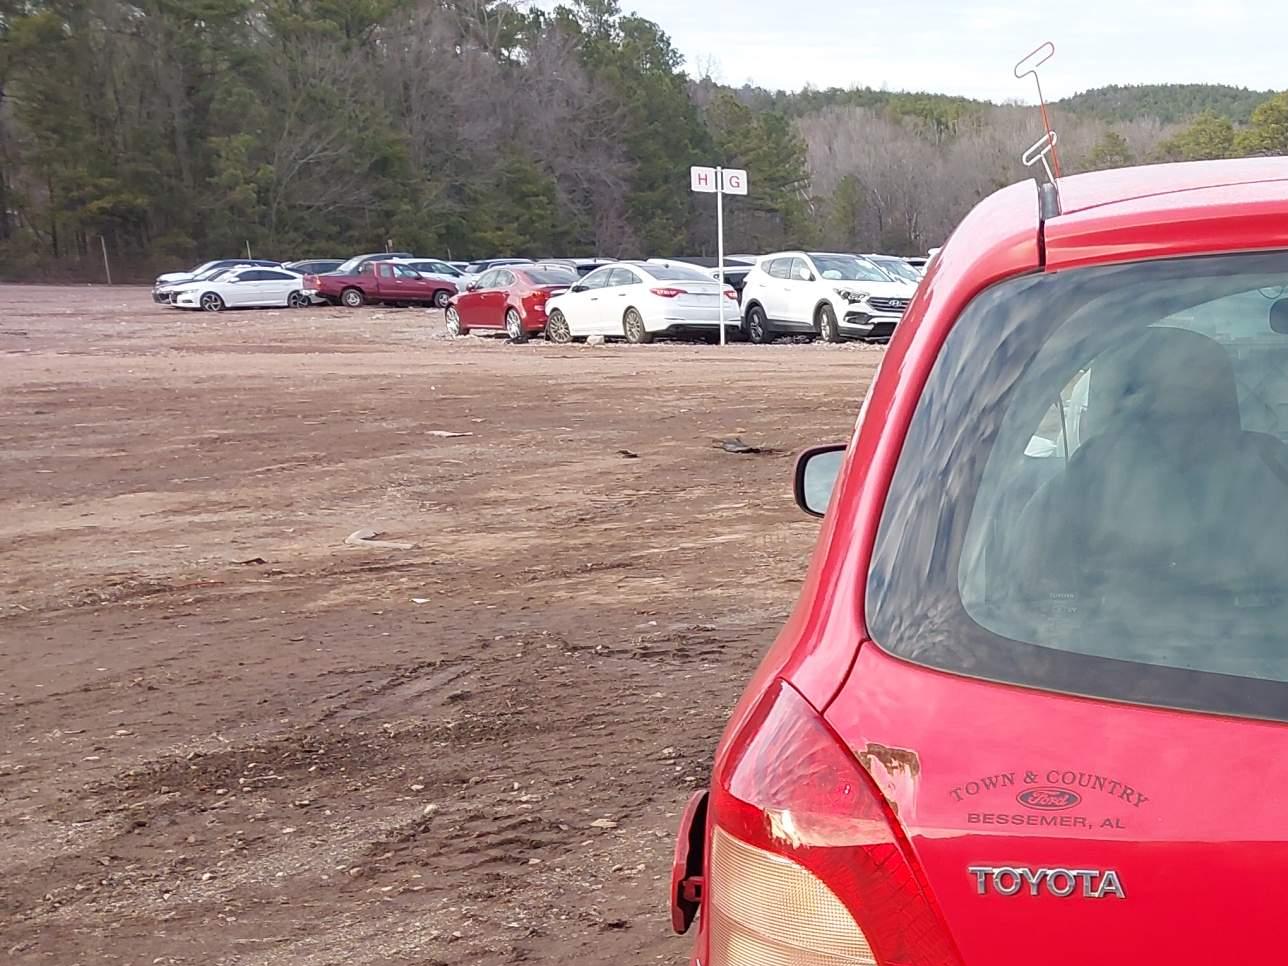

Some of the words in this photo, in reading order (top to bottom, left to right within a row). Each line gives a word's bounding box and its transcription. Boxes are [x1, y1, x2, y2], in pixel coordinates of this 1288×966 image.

[698, 173, 708, 186] H
[729, 176, 741, 188] G
[952, 773, 1015, 802] TOWN
[1023, 771, 1038, 784] &
[1047, 771, 1149, 807] COUNTRY
[968, 814, 1092, 829] BESSEMER,
[1101, 819, 1125, 829] AL
[968, 866, 1126, 899] TOYOTA
